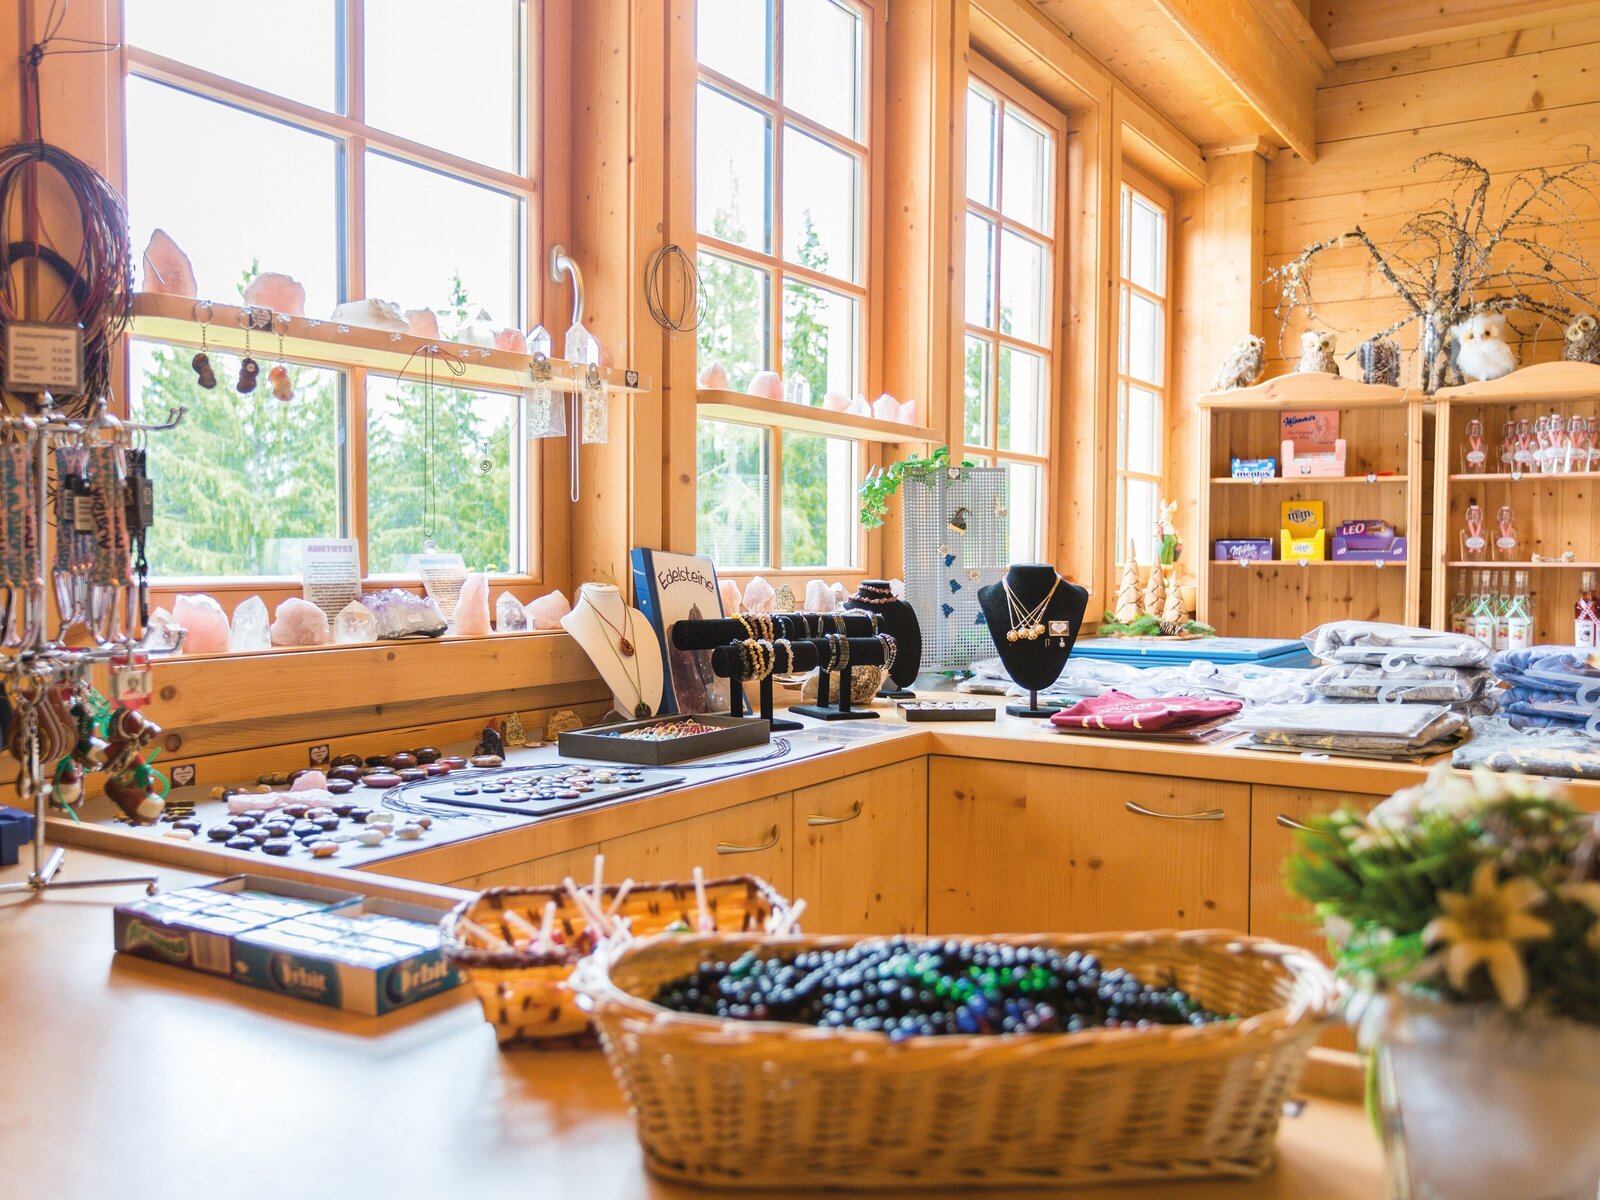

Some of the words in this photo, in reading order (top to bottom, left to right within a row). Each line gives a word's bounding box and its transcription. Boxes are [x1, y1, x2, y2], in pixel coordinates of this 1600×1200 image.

[1283, 415, 1316, 427] Manner
[92, 486, 111, 549] AUSTRIA
[1343, 523, 1365, 535] LEO
[307, 545, 353, 553] AMETHYST
[657, 566, 714, 593] Edelsteine
